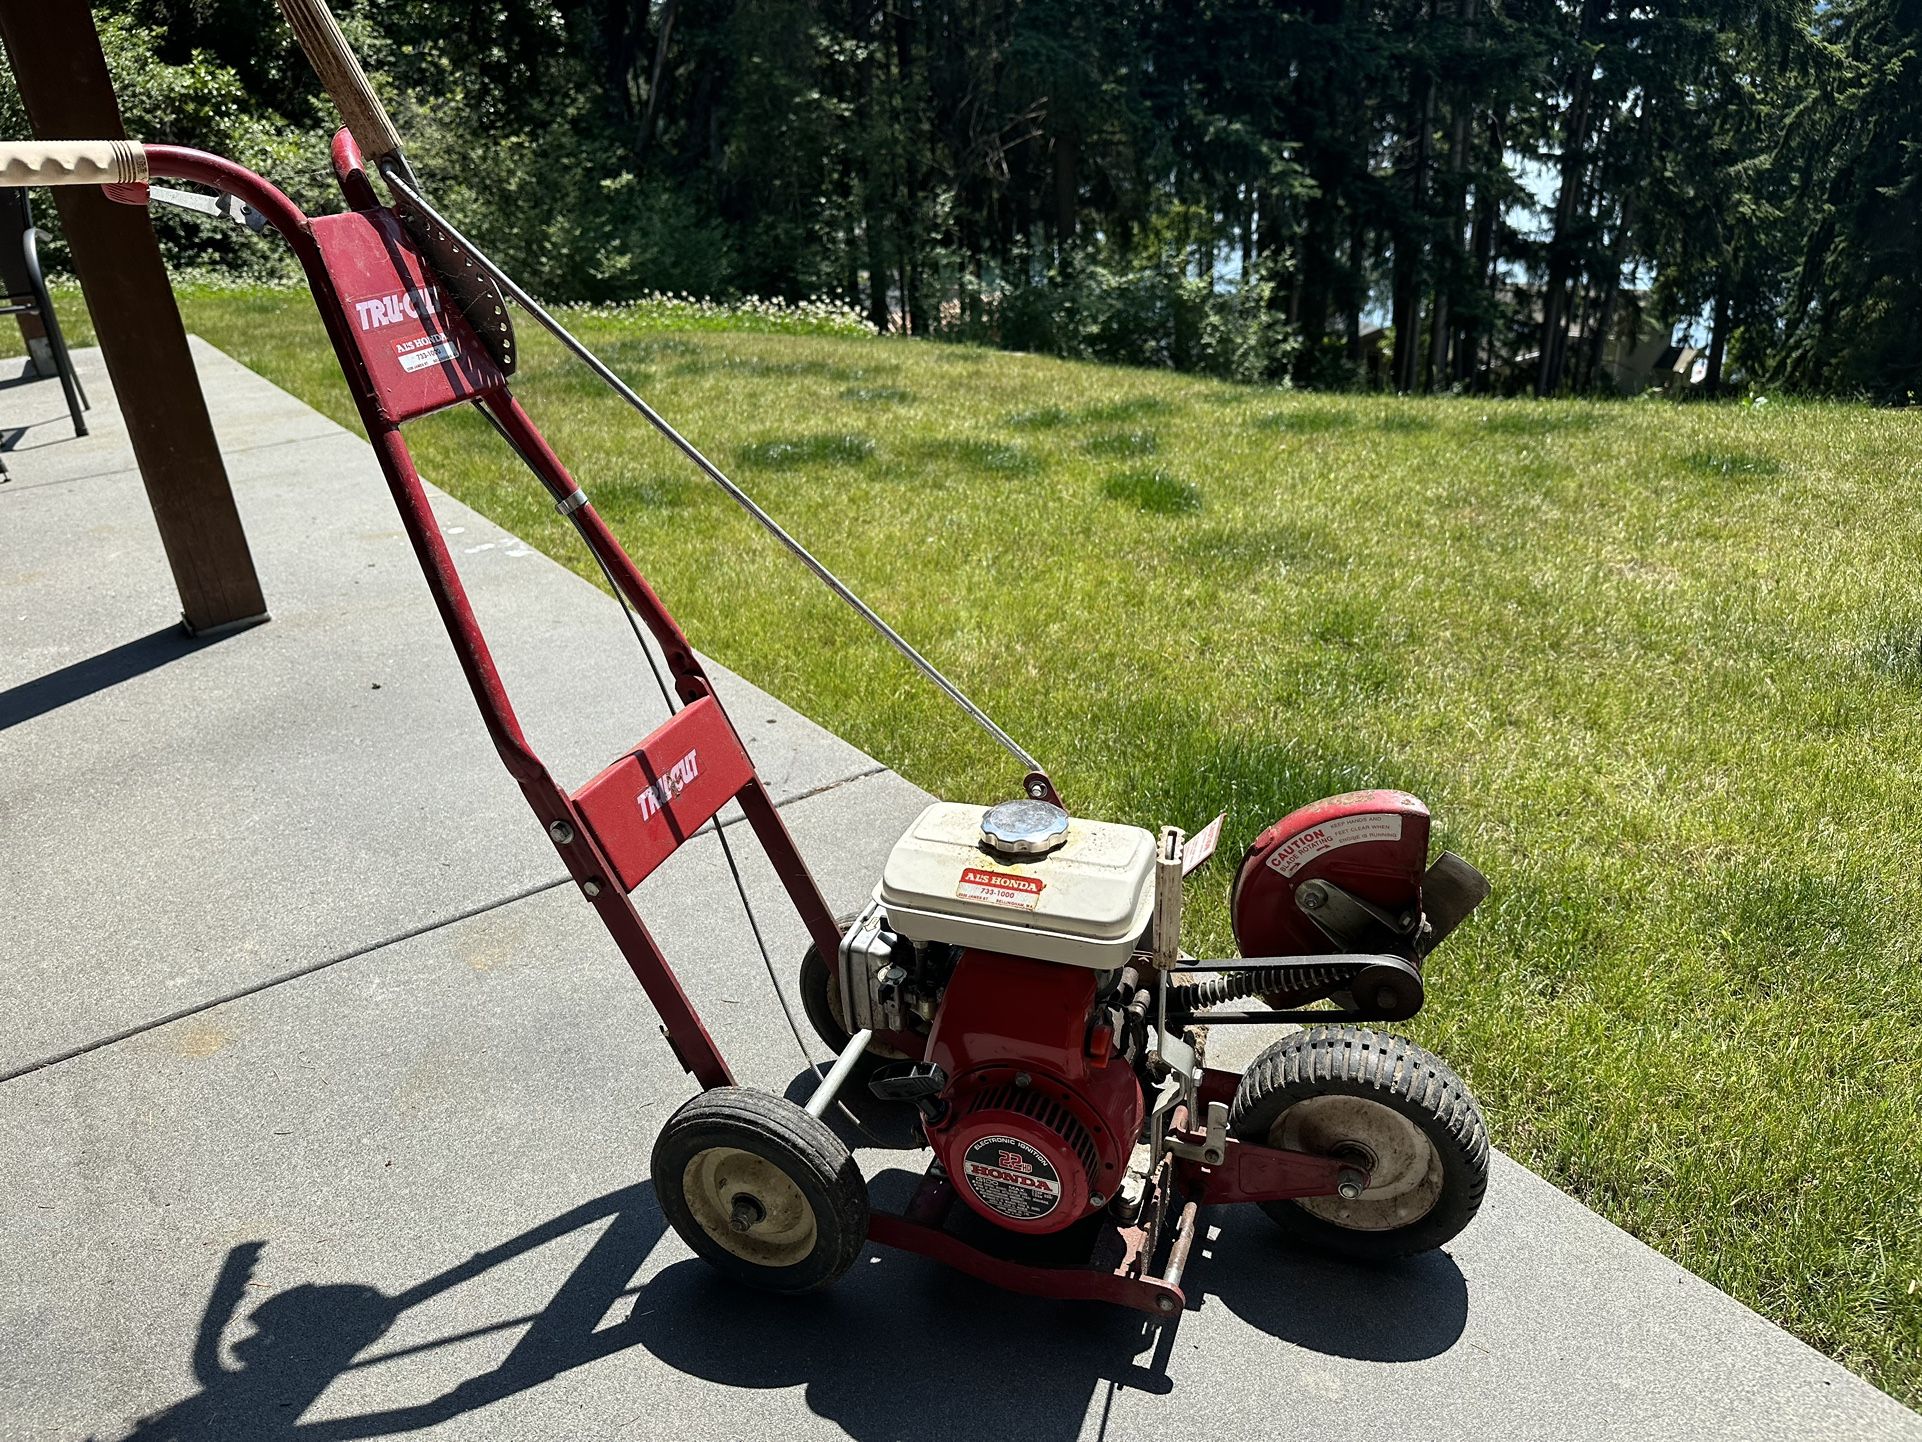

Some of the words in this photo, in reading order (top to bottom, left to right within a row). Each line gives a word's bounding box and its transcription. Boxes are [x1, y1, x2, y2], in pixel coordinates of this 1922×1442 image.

[356, 287, 440, 330] TRU-CUT
[396, 341, 415, 353] AL'S
[416, 333, 447, 347] HONDA
[1330, 821, 1346, 829] KEEP
[1346, 817, 1368, 825] HANDS
[1271, 829, 1325, 867] CAUTION
[1280, 854, 1300, 872] BLADE
[1299, 835, 1334, 855] ROTATING
[965, 872, 990, 883] AL'S
[990, 877, 1038, 891] HONDA
[980, 887, 1015, 899] 733-1000
[974, 1137, 1016, 1151] ELECTRONIC
[1017, 1142, 1048, 1167] IGNITION
[971, 1164, 1053, 1192] HONDA
